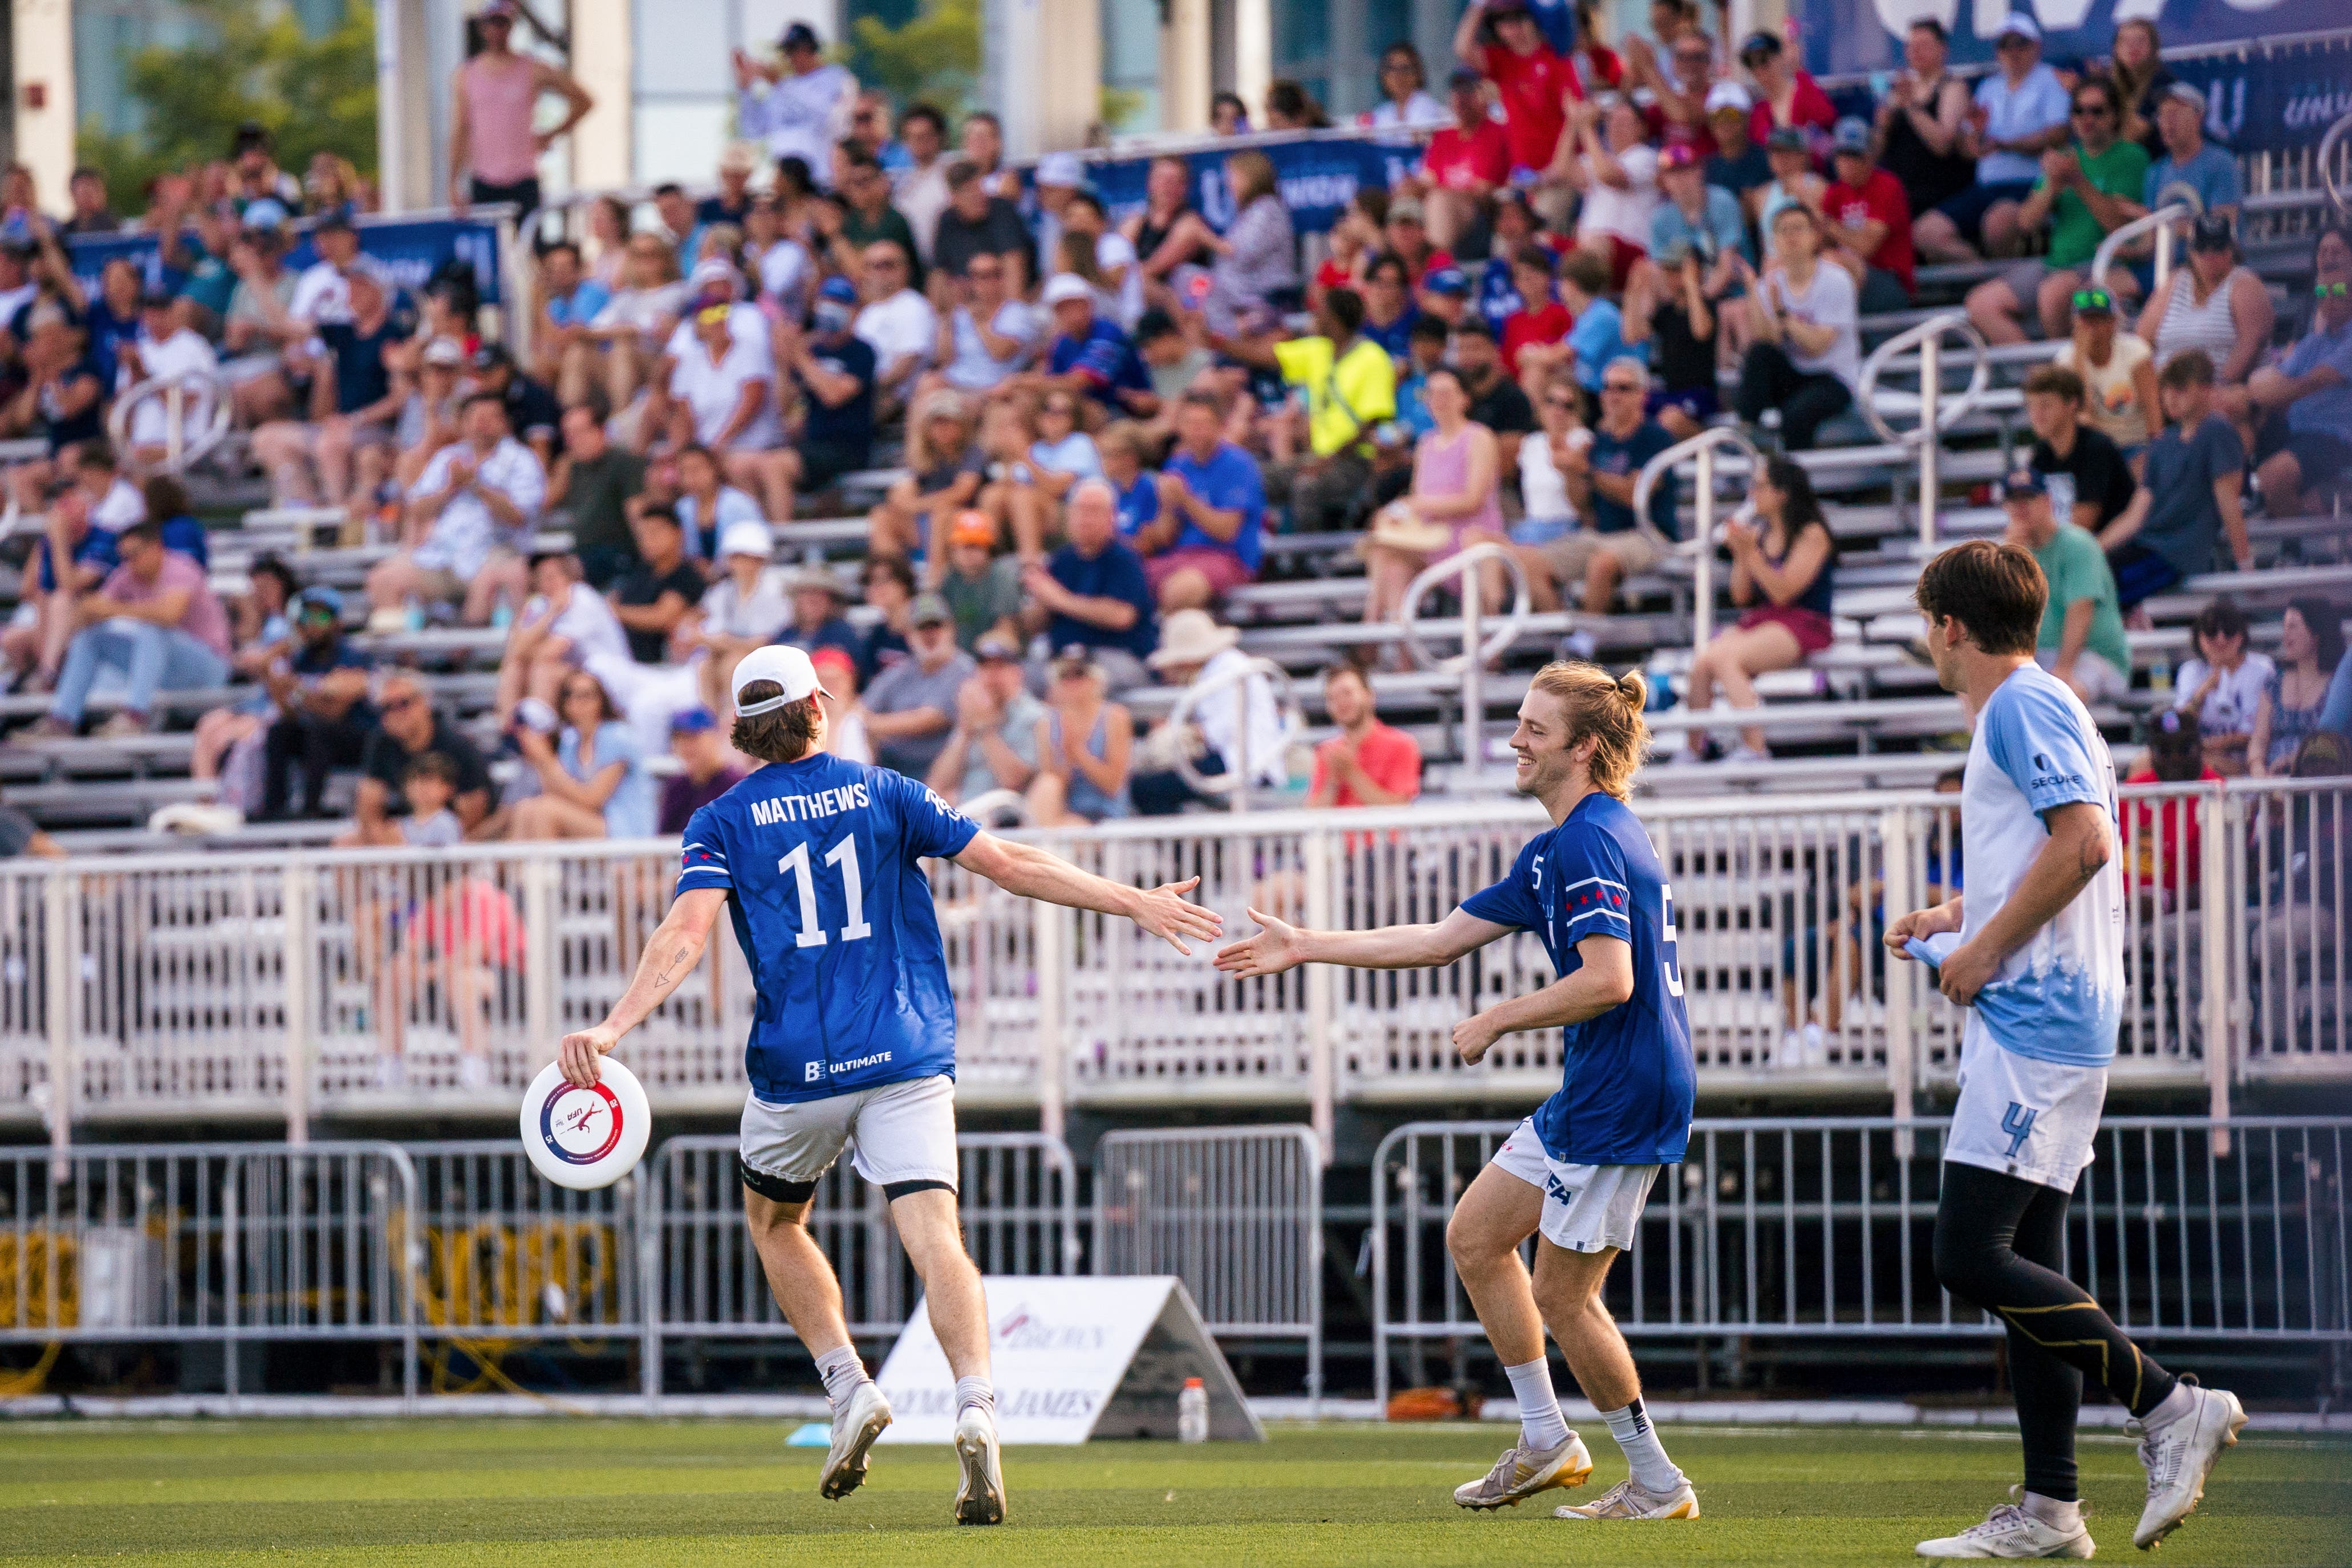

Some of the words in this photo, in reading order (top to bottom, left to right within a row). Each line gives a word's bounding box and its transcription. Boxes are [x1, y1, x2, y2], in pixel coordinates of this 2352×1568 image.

[750, 783, 870, 826] MATTHEWS
[778, 832, 871, 948] 11
[1532, 854, 1544, 889] 5
[1662, 884, 1684, 997] 5
[830, 1051, 892, 1073] ULTIMATE
[567, 1108, 583, 1121] UFA
[2001, 1101, 2038, 1157] 4
[1547, 1171, 1571, 1206] FA
